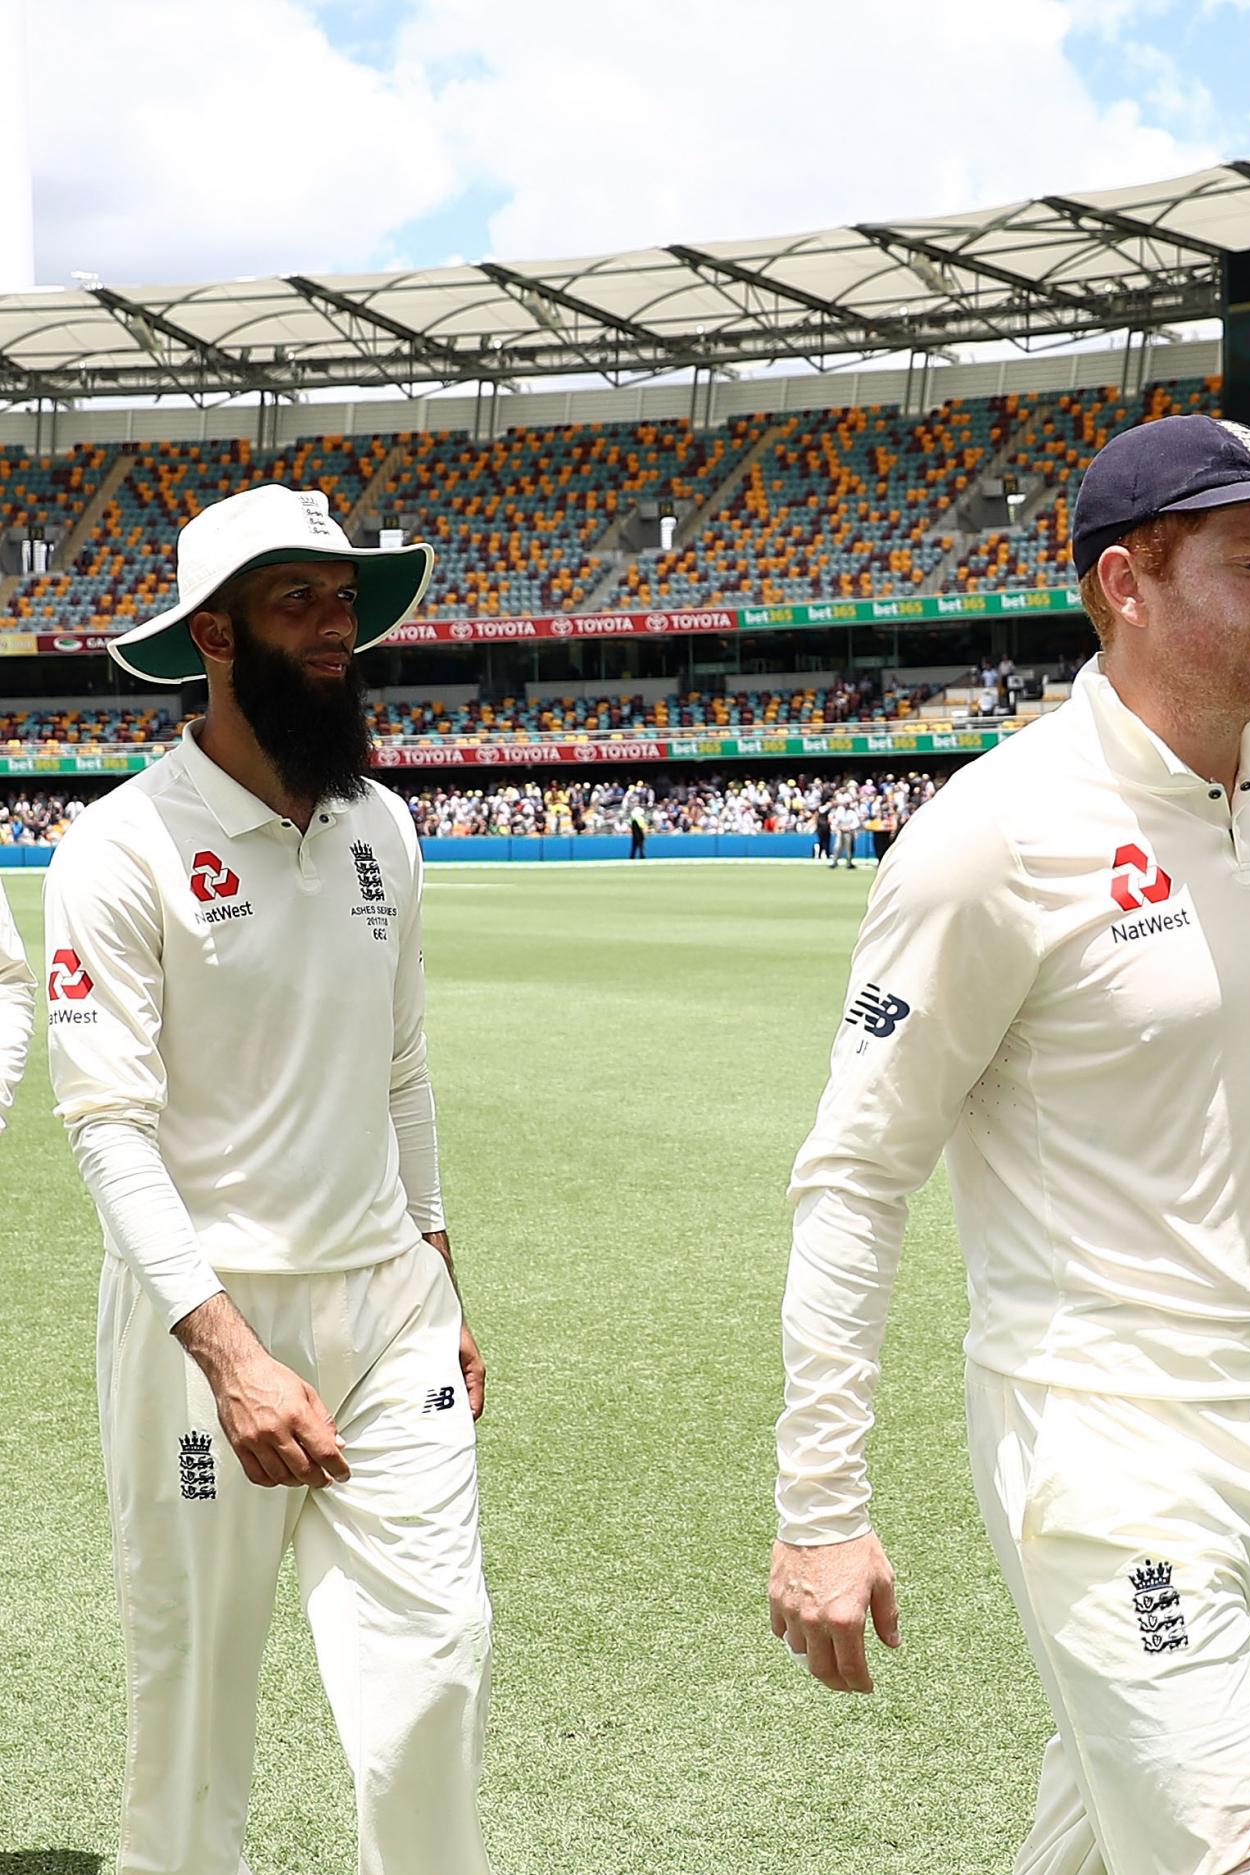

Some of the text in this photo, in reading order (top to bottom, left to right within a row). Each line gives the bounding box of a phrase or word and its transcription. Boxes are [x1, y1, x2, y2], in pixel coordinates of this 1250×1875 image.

[873, 600, 923, 618] bet365
[937, 595, 986, 612] bet365
[1001, 592, 1050, 609] bet365
[744, 608, 793, 625] bet365
[807, 603, 857, 621] bet365
[474, 621, 536, 637] TOYOTA
[574, 616, 634, 633] TOYOTA
[670, 612, 731, 630] TOYOTA
[387, 625, 437, 641] OYOTA
[403, 749, 464, 765] TOYOTA
[502, 746, 561, 762] TOYOTA
[600, 743, 660, 758] TOYOTA
[194, 900, 254, 925] NatWest
[351, 905, 376, 916] ASHES
[1111, 907, 1192, 944] NatWest
[49, 1008, 98, 1026] atWest
